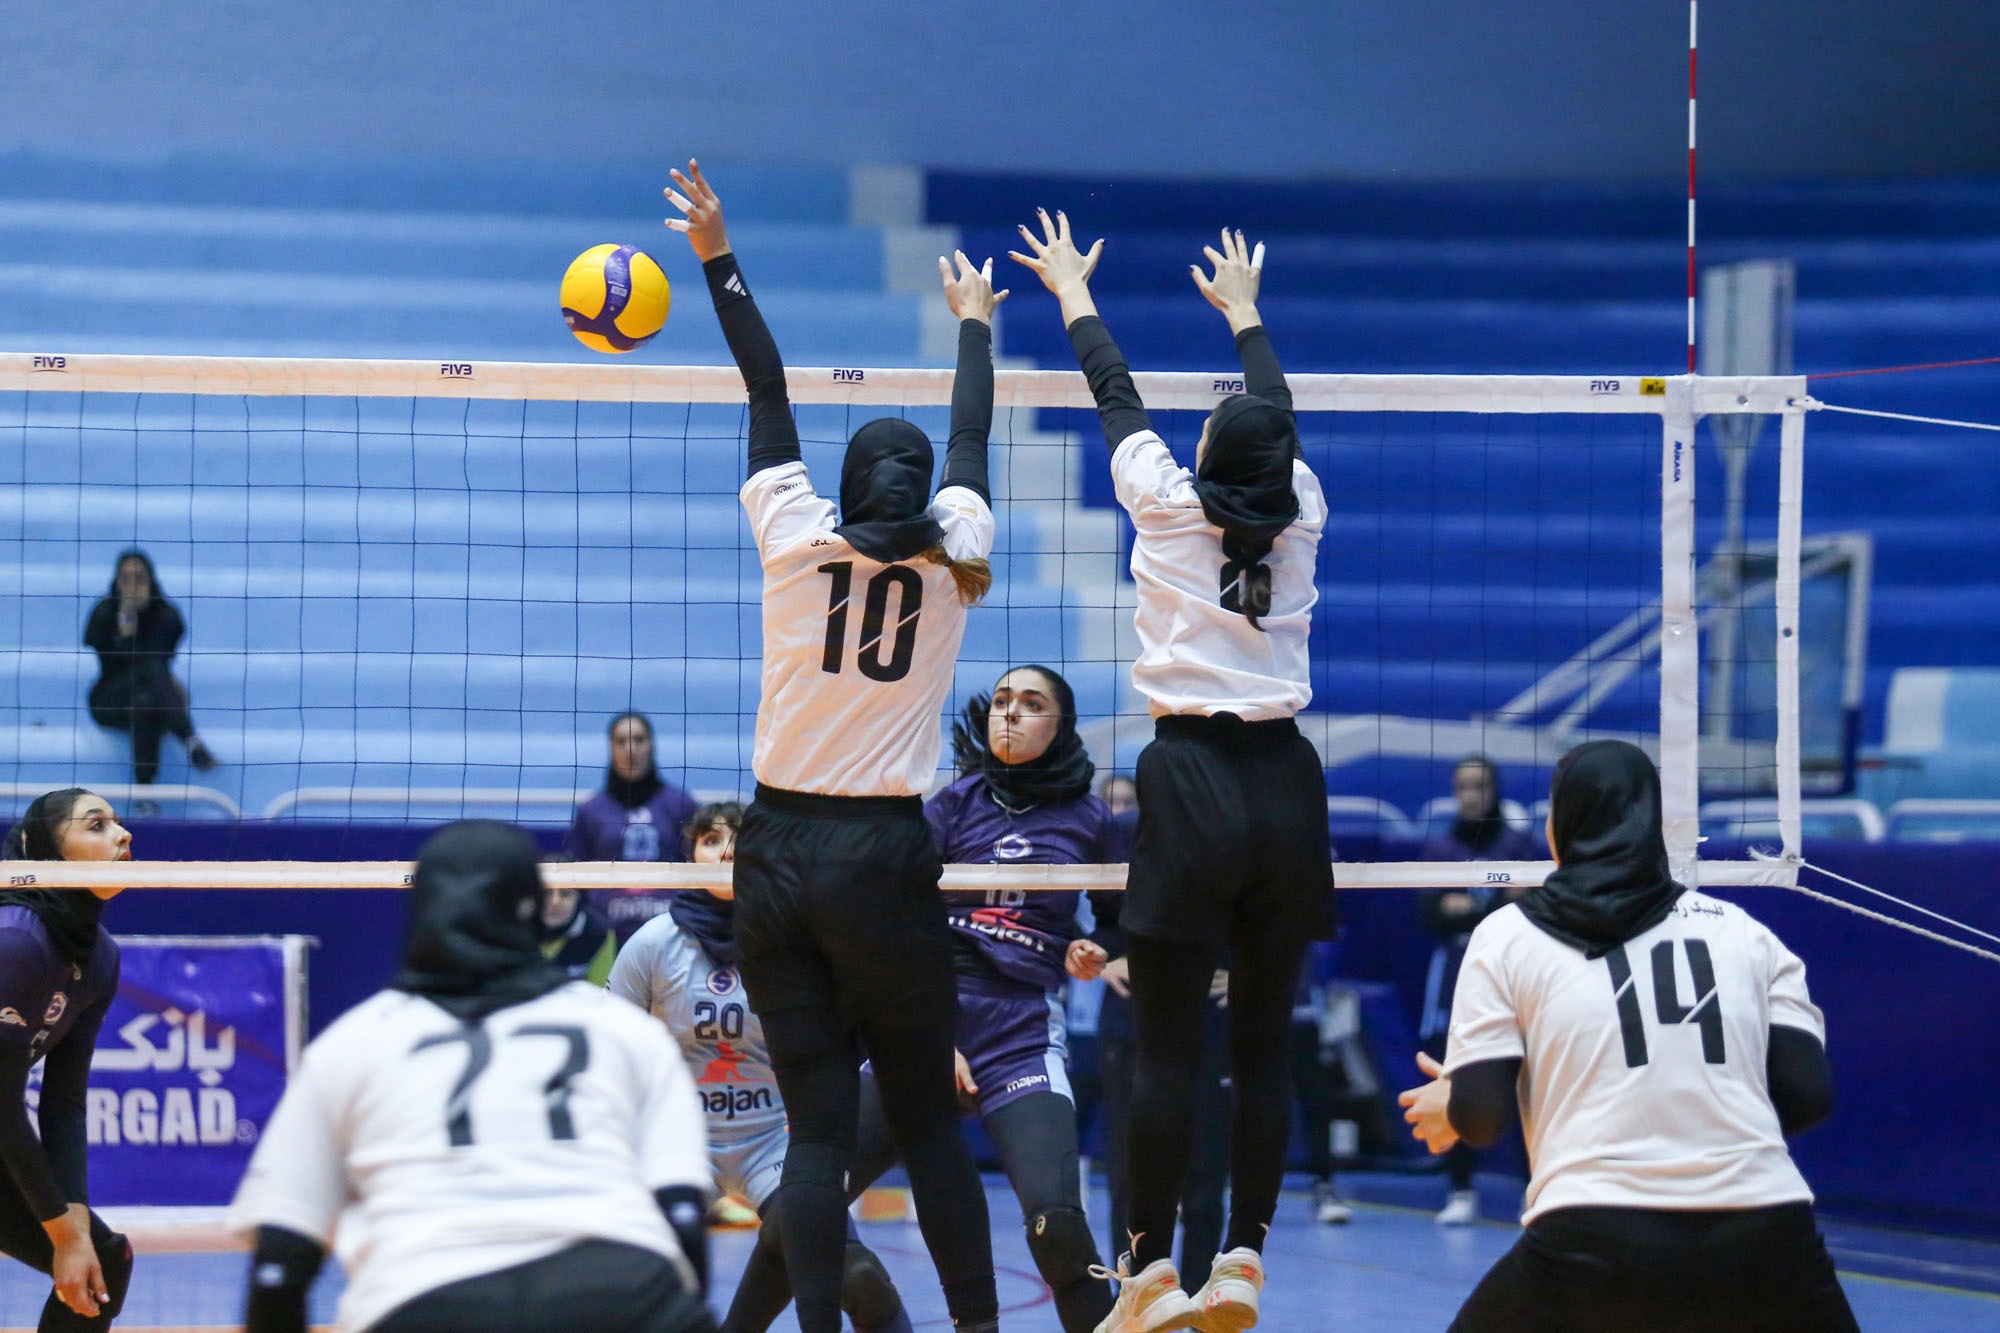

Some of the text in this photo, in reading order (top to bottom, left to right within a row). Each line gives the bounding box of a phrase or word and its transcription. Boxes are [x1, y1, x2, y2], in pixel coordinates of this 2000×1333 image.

[33, 356, 66, 369] FIVB
[440, 363, 473, 376] FIVB
[833, 368, 865, 381] FIVB
[1213, 379, 1244, 392] FIVB
[1590, 380, 1621, 391] FIVB
[817, 560, 924, 683] 10
[10, 874, 37, 885] FIVB
[1486, 872, 1511, 881] FIVB
[1604, 937, 1726, 1069] 14
[694, 1001, 744, 1040] 20
[90, 1007, 236, 1087] بانک
[406, 1022, 591, 1147] 77
[1006, 1074, 1048, 1093] majan
[86, 1087, 237, 1147] RGAD
